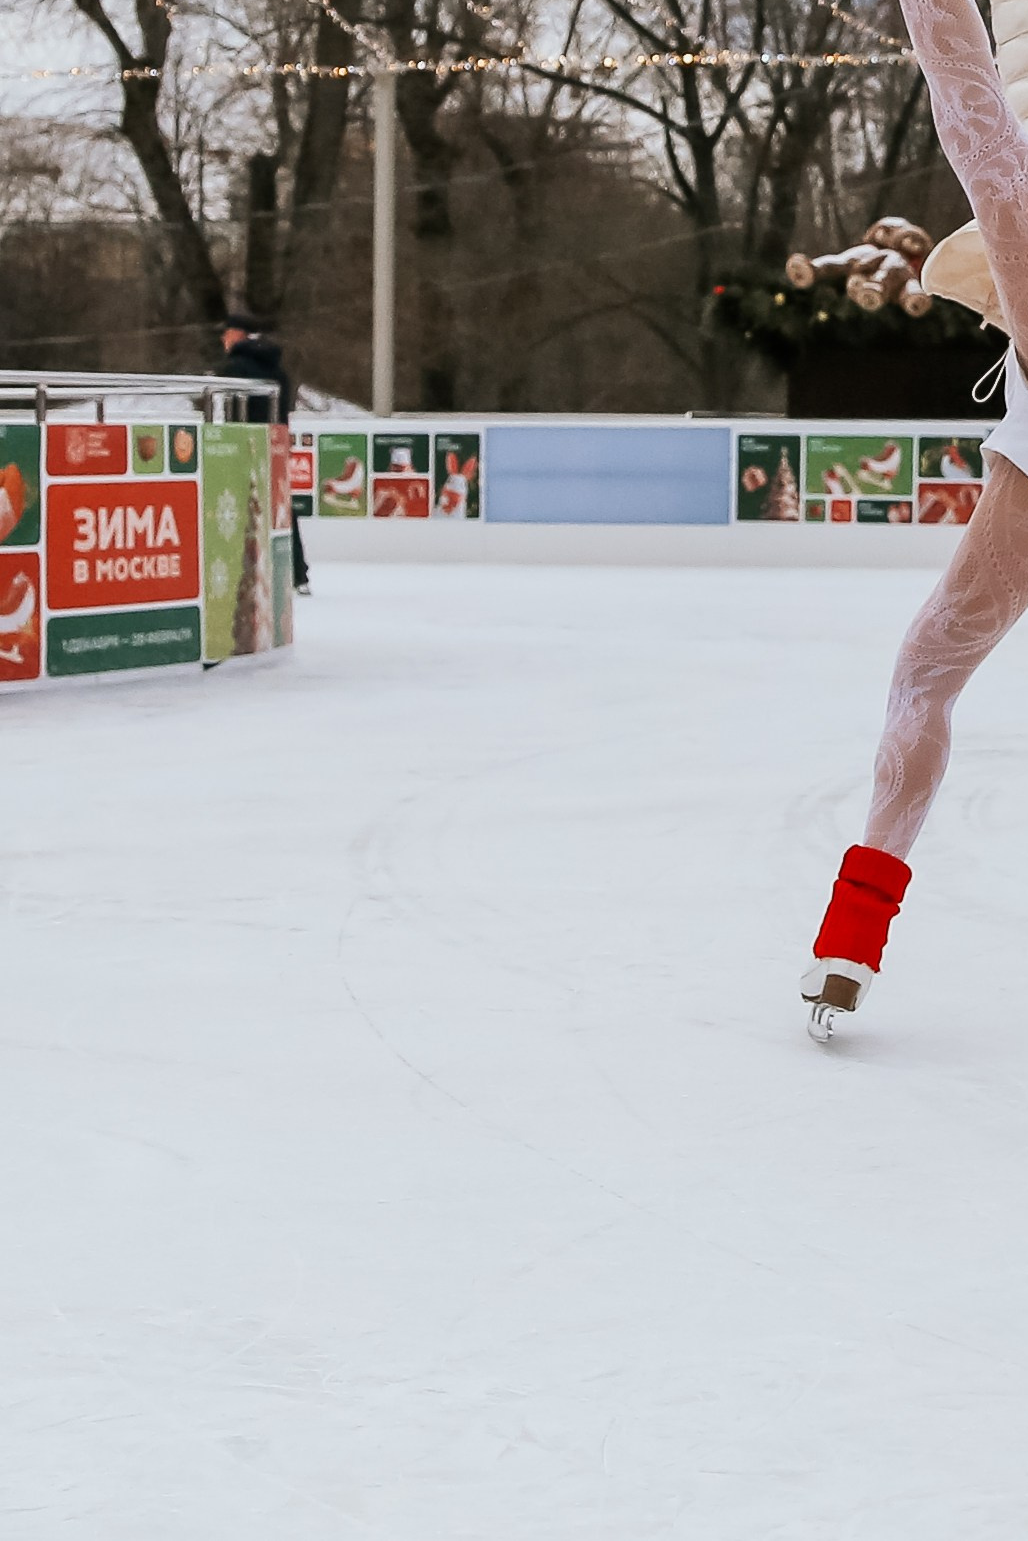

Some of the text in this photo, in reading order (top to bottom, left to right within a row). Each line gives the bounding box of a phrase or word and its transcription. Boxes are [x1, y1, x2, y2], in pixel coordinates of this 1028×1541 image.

[73, 505, 181, 552] ЗИМА
[73, 553, 181, 584] В МОСКВЕ
